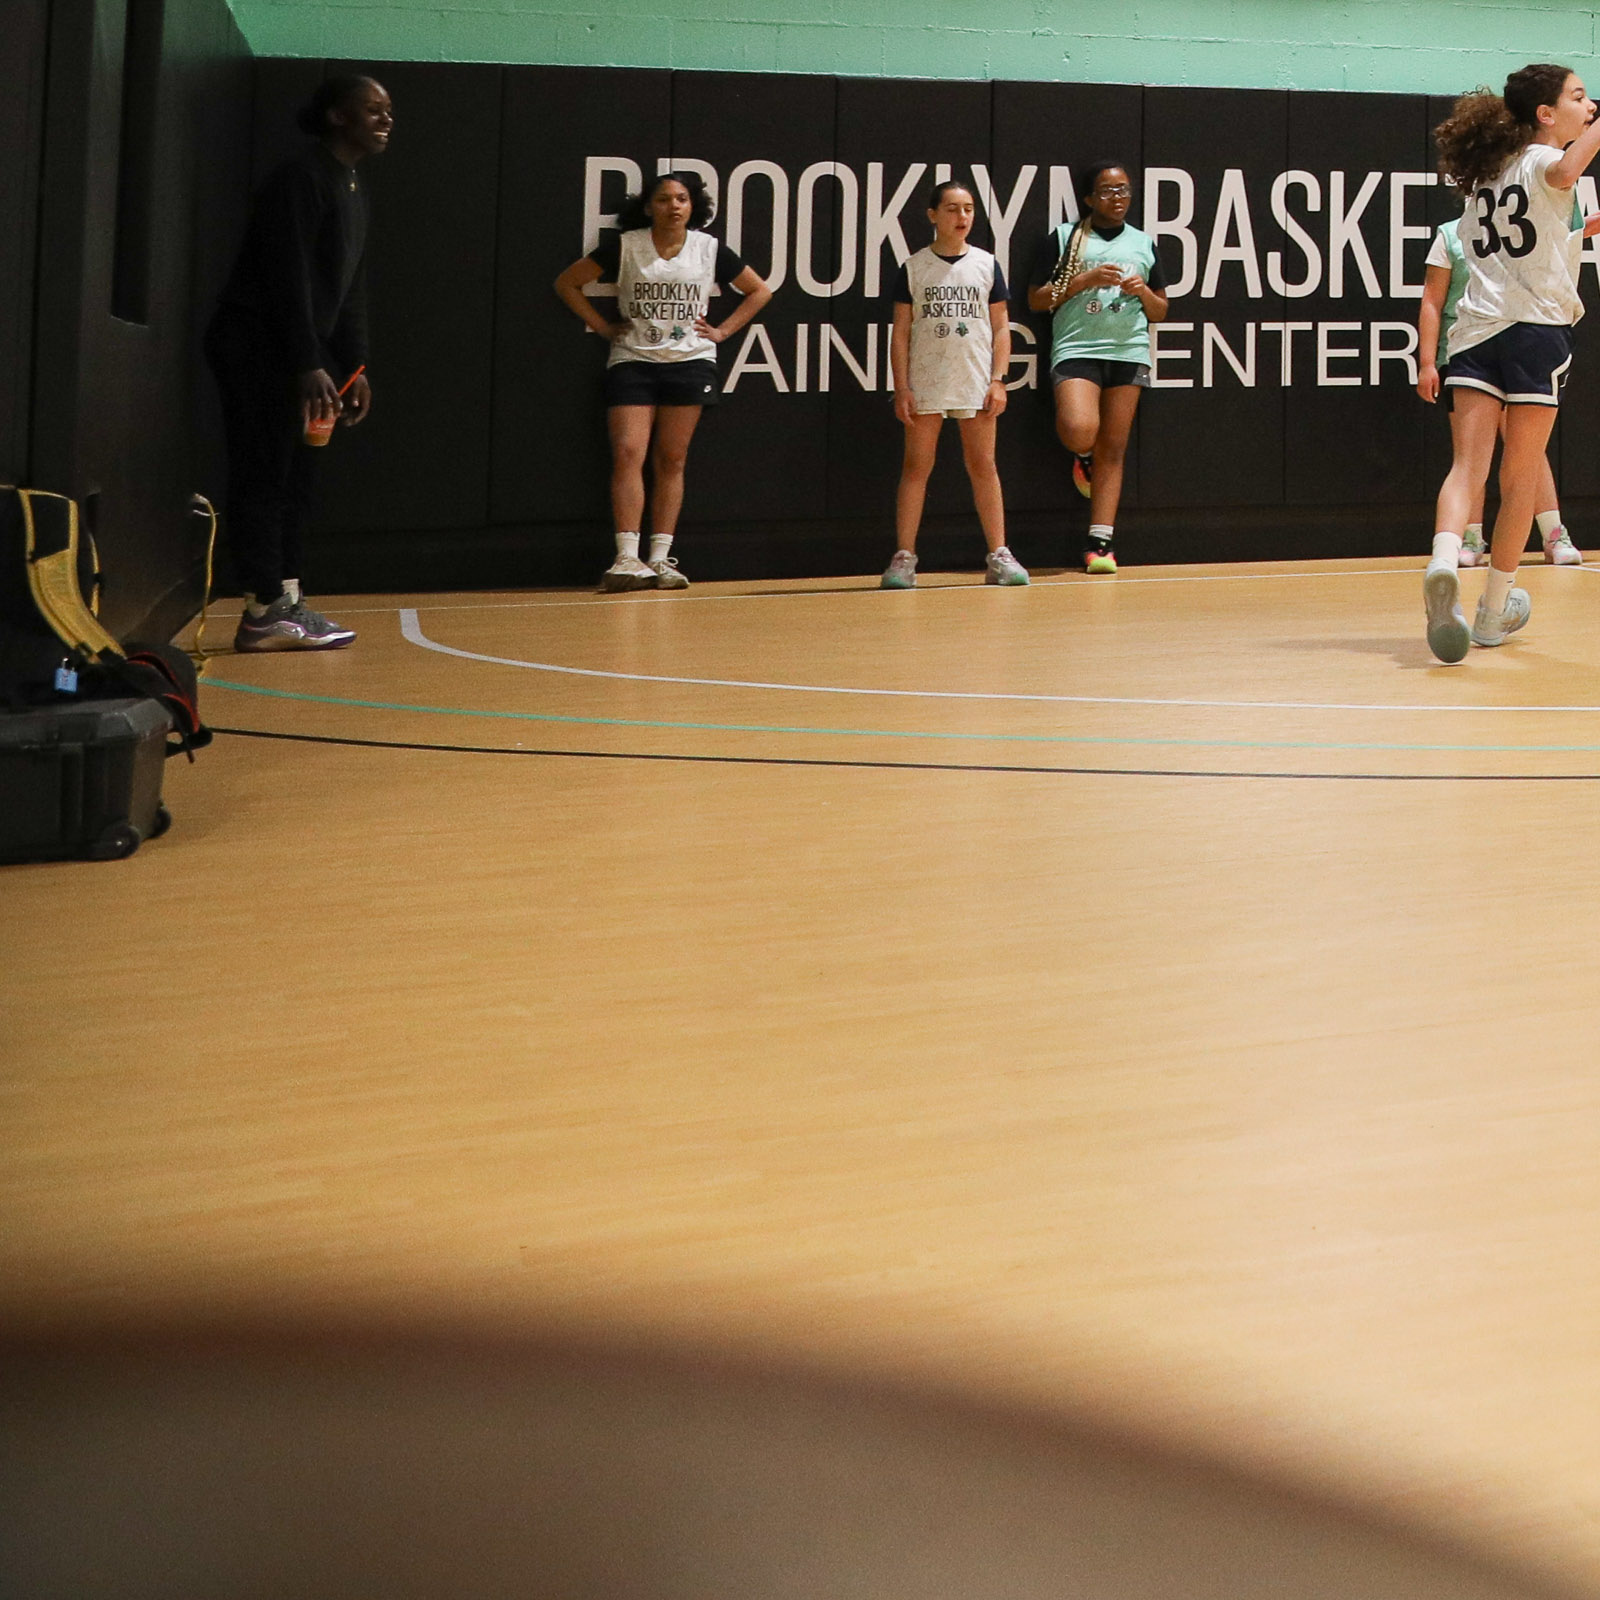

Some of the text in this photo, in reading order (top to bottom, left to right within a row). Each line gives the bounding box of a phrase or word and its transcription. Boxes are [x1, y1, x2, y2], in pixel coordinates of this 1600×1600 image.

[1472, 184, 1537, 259] 33
[634, 282, 701, 301] BROOKLYN
[925, 286, 980, 302] BROOKLYN
[1150, 321, 1419, 388] ENTER
